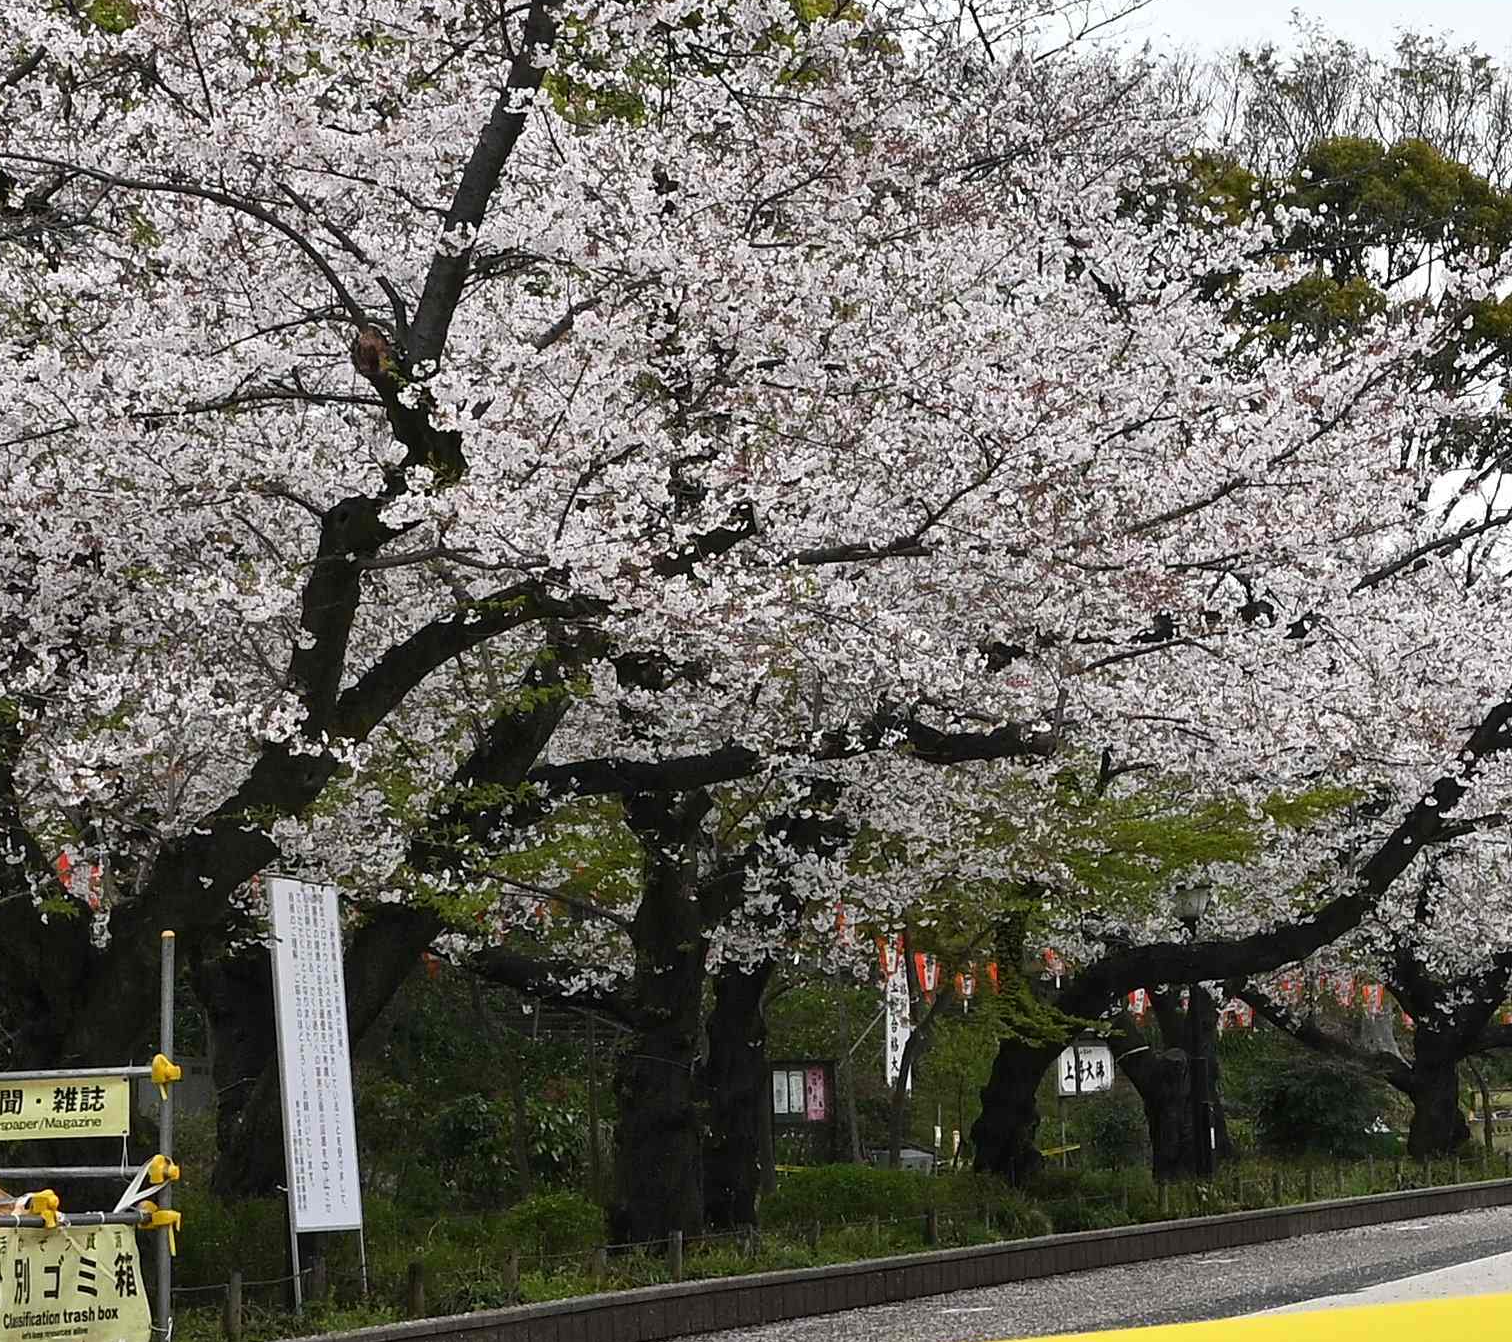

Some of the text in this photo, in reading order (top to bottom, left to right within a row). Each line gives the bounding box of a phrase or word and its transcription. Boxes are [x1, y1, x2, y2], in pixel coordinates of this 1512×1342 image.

[2, 1304, 120, 1330] Classification trash box
